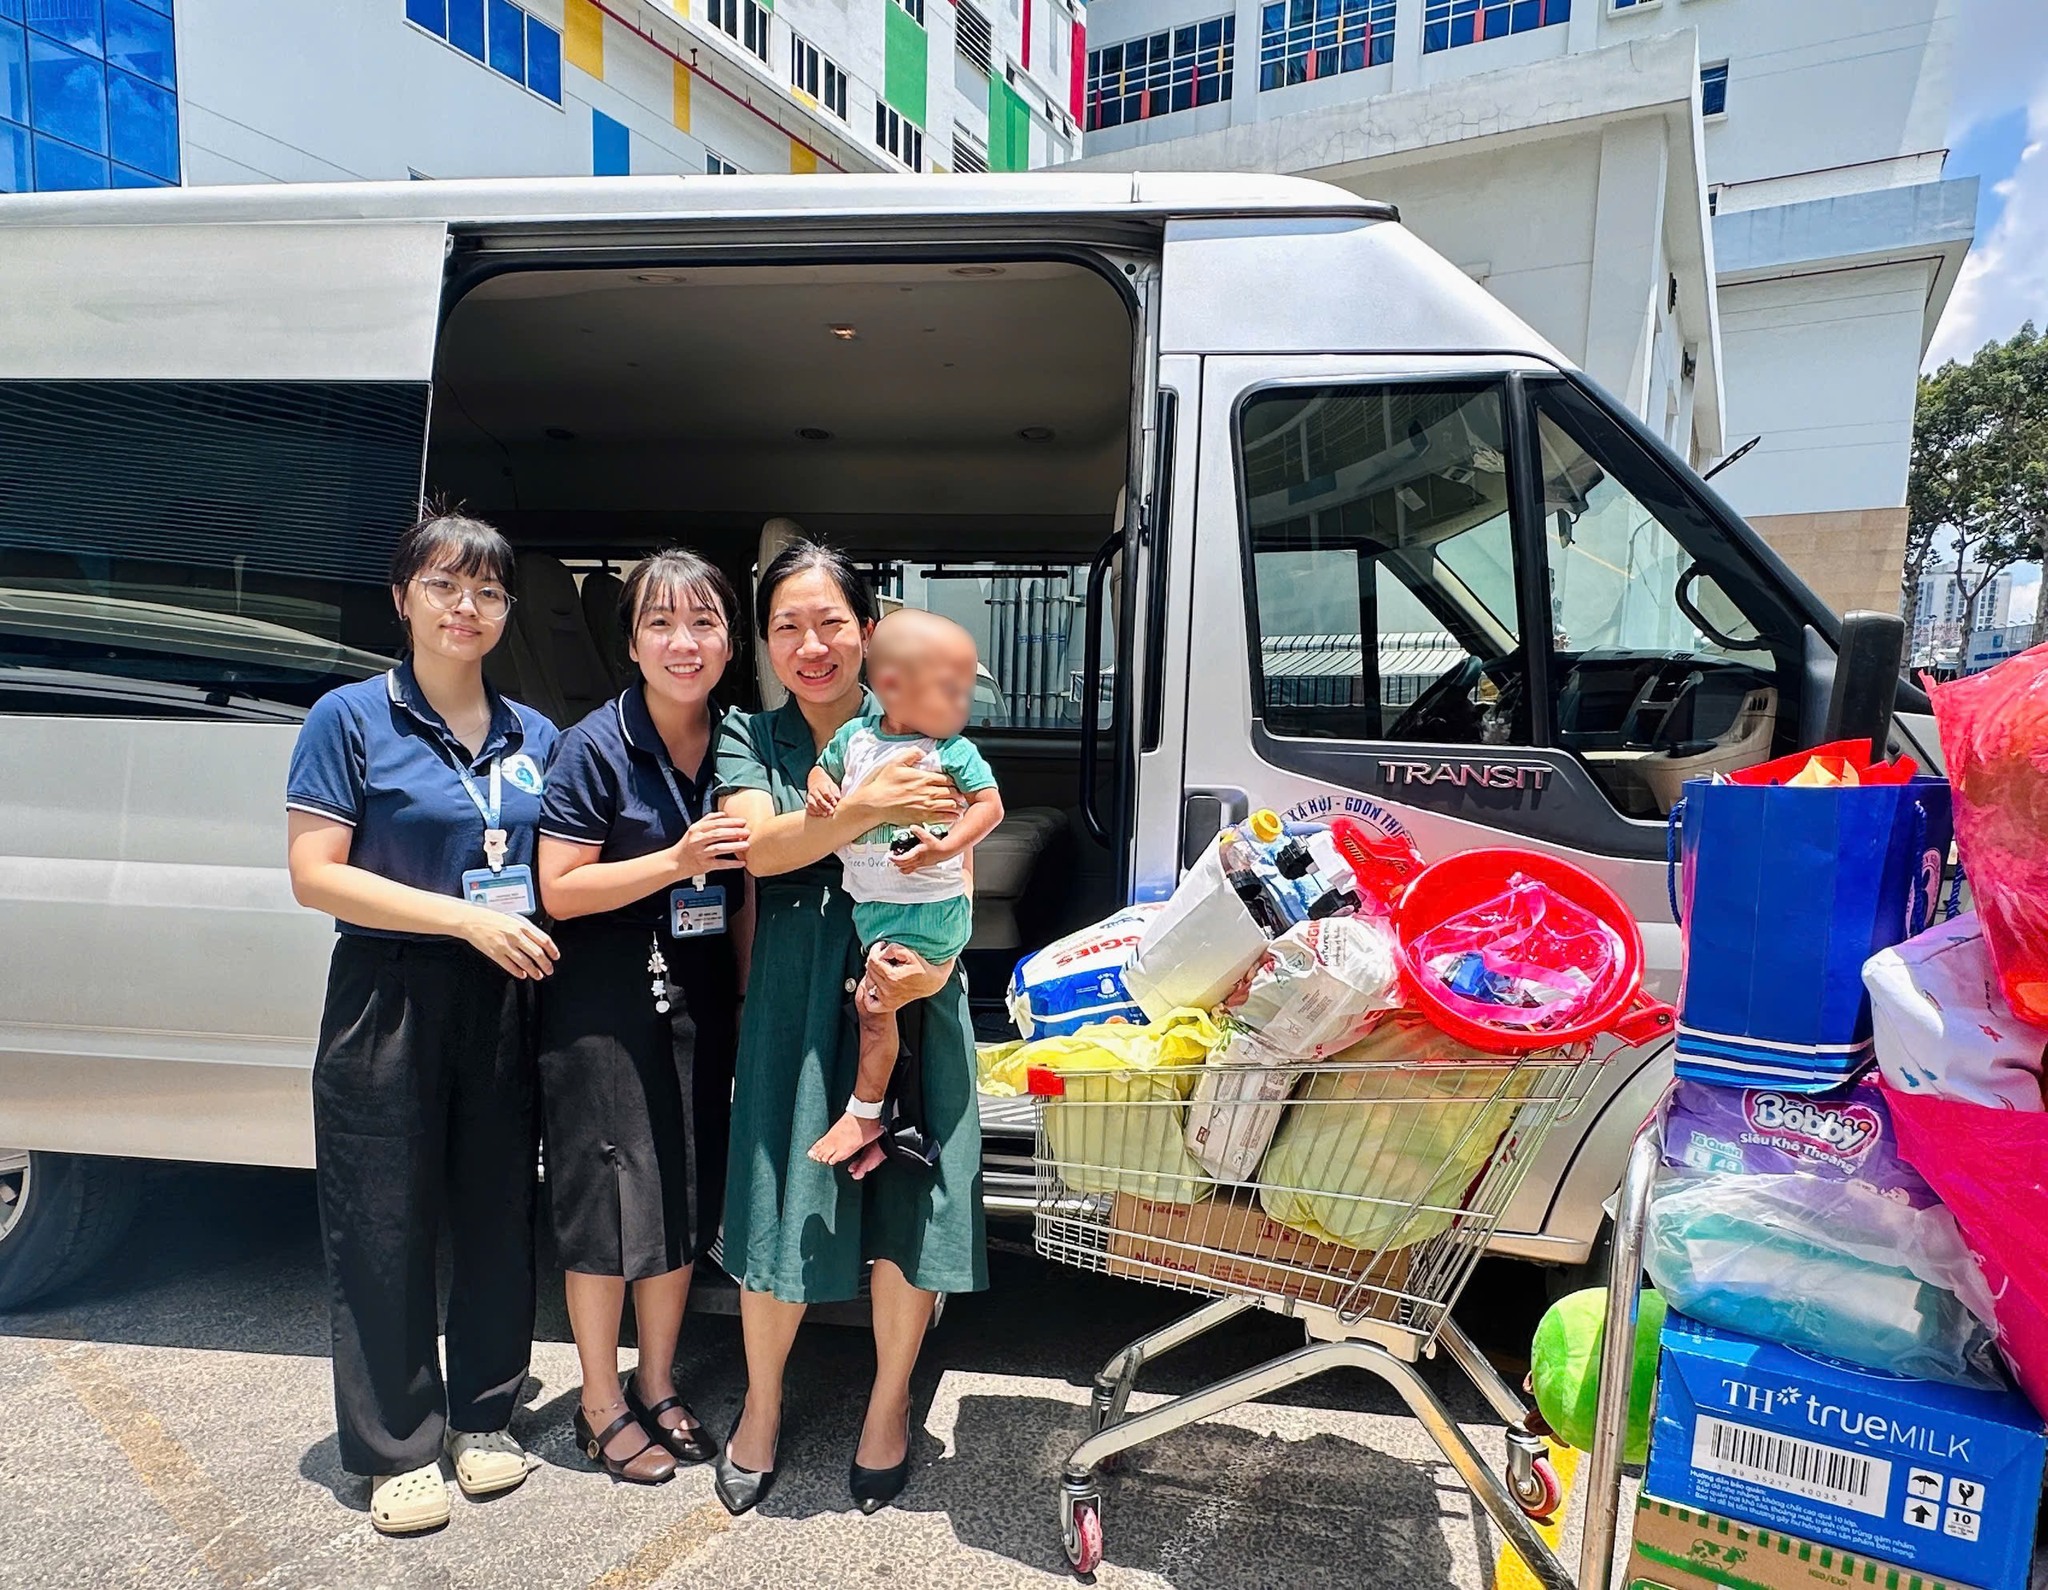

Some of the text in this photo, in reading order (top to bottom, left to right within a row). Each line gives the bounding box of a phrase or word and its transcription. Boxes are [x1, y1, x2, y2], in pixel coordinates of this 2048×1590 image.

[1378, 760, 1552, 790] TRANSIT
[1754, 1092, 1873, 1152] Bobby
[1721, 1379, 1777, 1415] TH
[1952, 1511, 1971, 1524] 10
